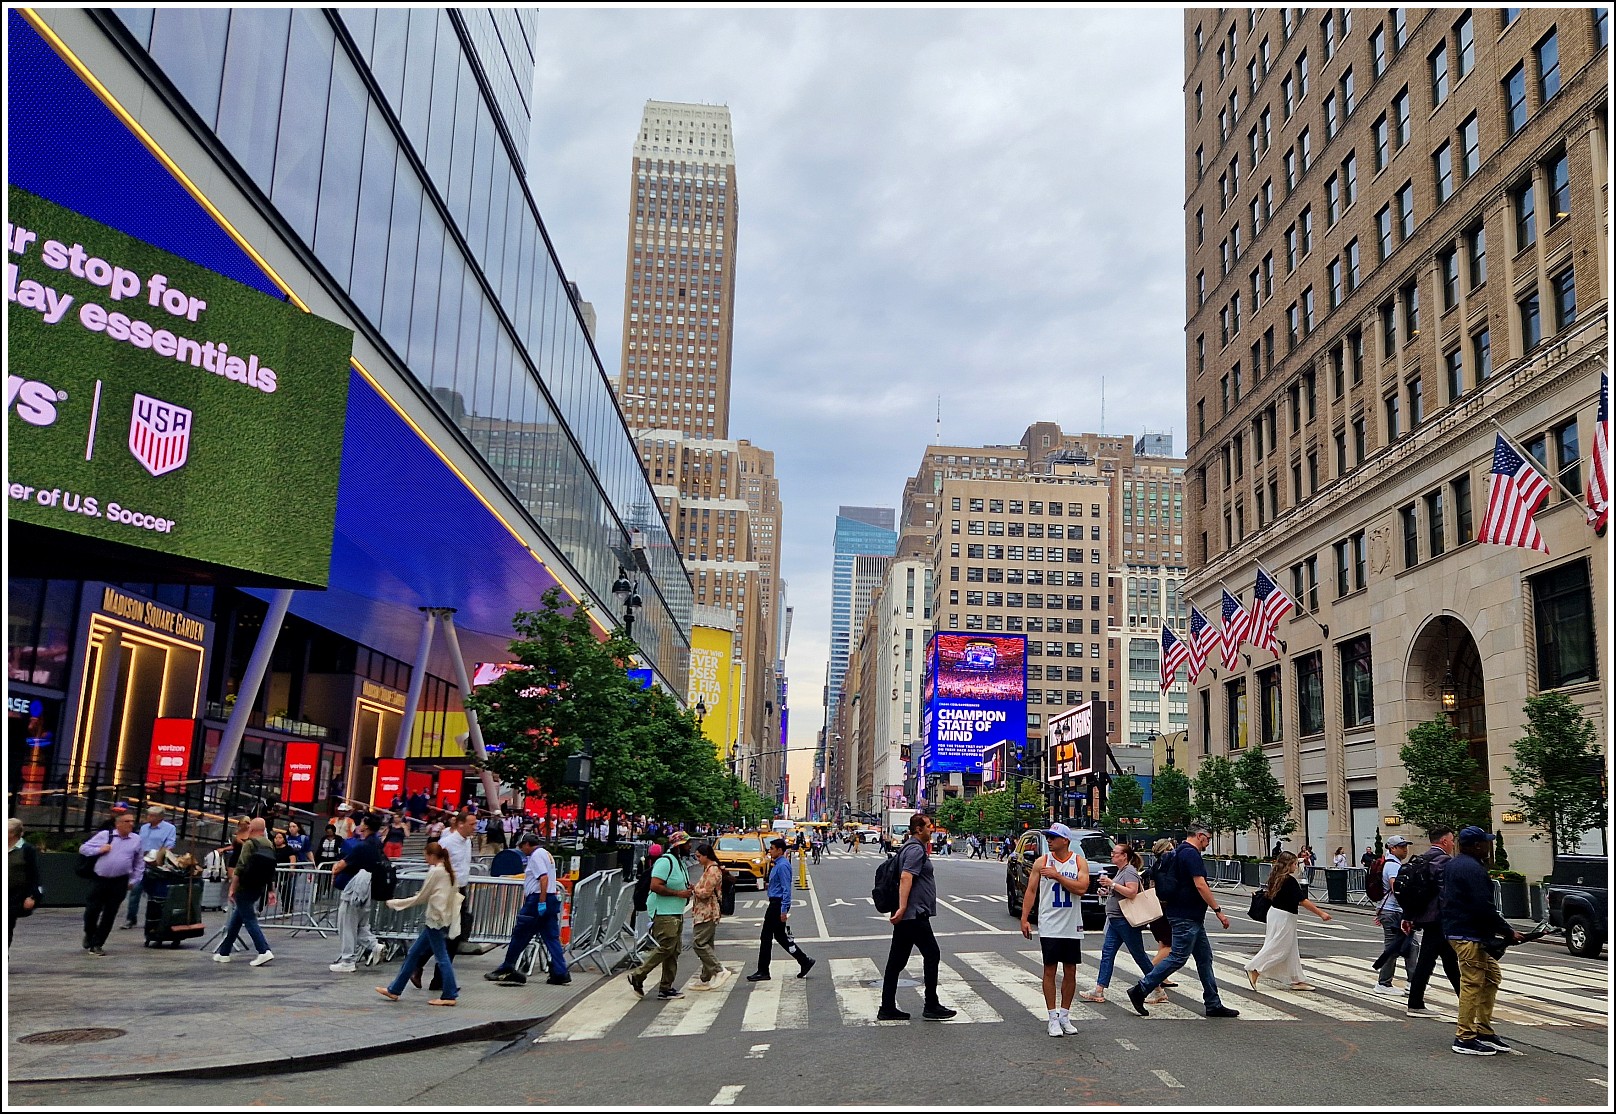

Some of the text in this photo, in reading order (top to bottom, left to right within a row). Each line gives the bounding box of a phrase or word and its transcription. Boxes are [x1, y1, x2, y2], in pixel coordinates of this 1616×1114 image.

[8, 222, 207, 322] r stop for
[79, 303, 278, 394] essentials
[138, 400, 188, 433] USA
[37, 488, 60, 508] of
[63, 492, 102, 517] U.S.
[106, 503, 175, 533] Soccer
[103, 587, 205, 642] MADISON SQUARE GARDEN
[700, 679, 721, 694] FIFA
[937, 719, 992, 732] STATE OF
[938, 709, 1006, 722] CHAMPION
[157, 744, 186, 752] verizon
[937, 730, 973, 742] MIND
[1051, 882, 1073, 908] 11
